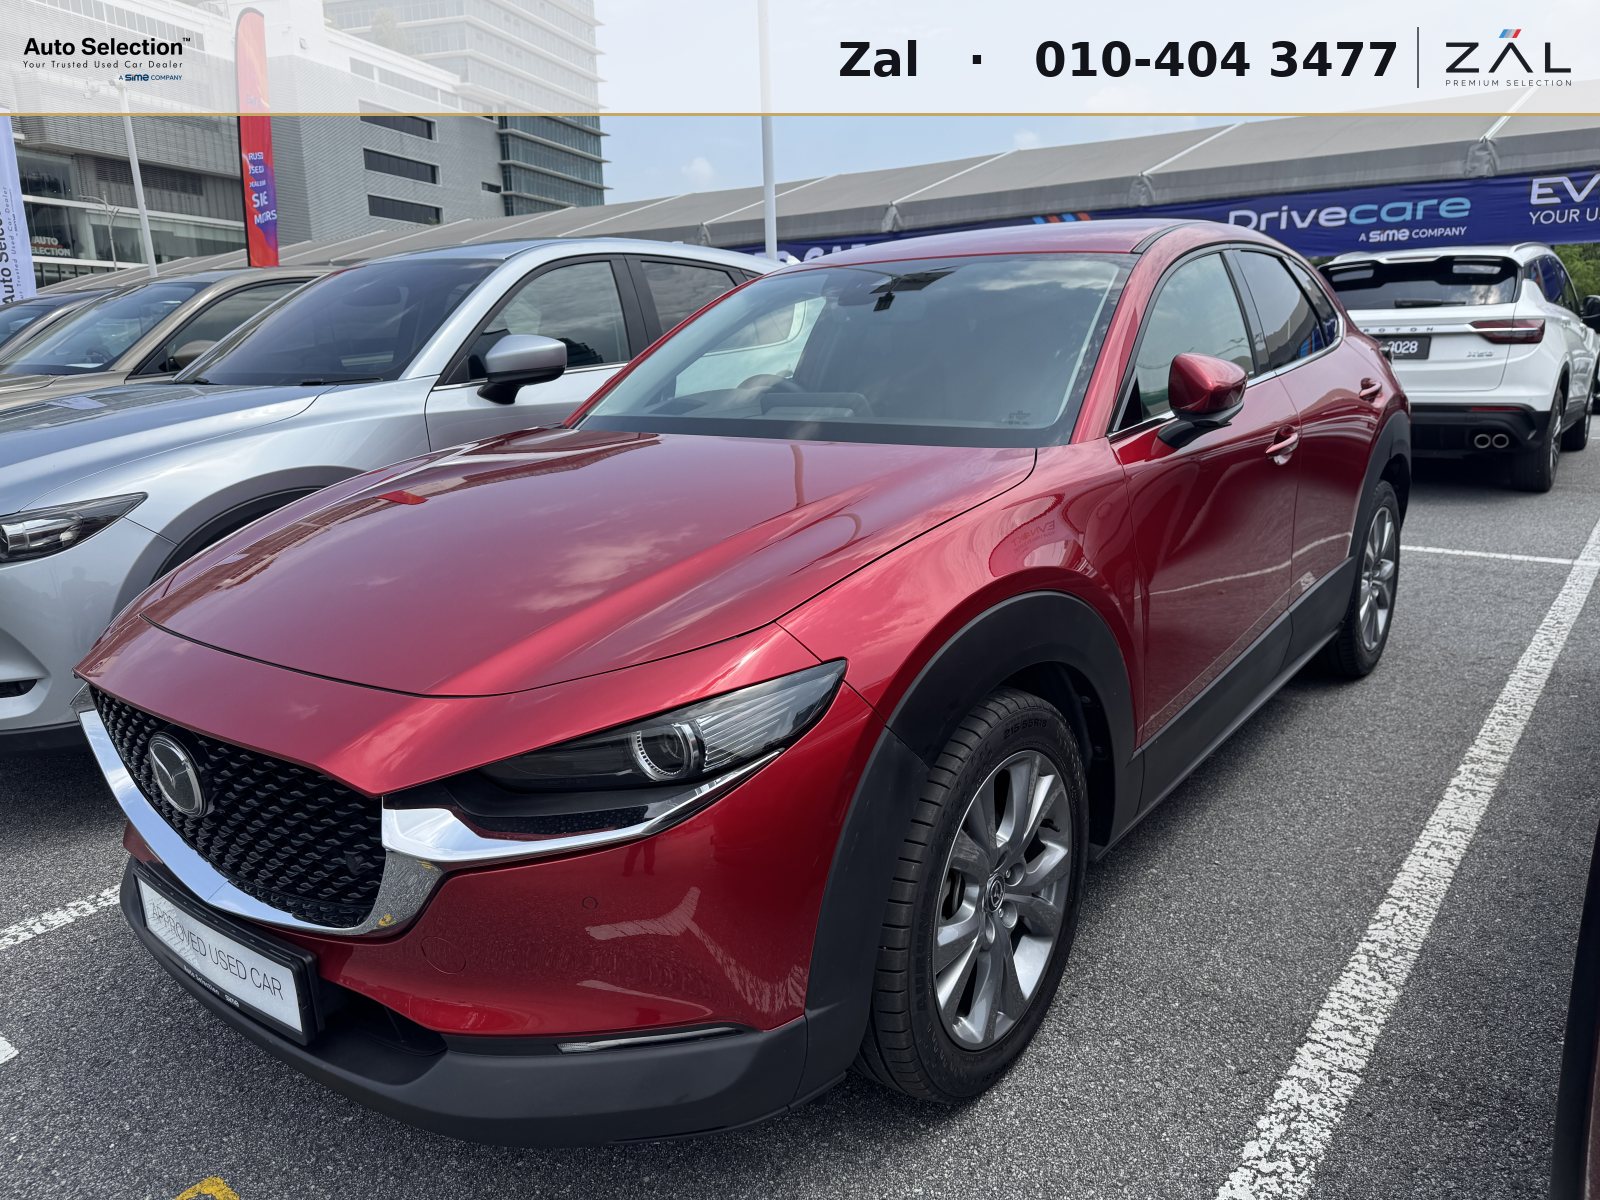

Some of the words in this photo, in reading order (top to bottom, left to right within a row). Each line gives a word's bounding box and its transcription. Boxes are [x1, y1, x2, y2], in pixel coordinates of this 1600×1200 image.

[1228, 196, 1471, 231] Drivecare
[1529, 209, 1580, 225] YOUR
[1586, 207, 1600, 221] U
[1358, 233, 1367, 242] A
[1411, 226, 1467, 239] COMPANY
[32, 246, 71, 256] ELECTION
[152, 902, 207, 957] APPROVED
[208, 944, 247, 980] USED
[250, 967, 284, 1001] CAR
